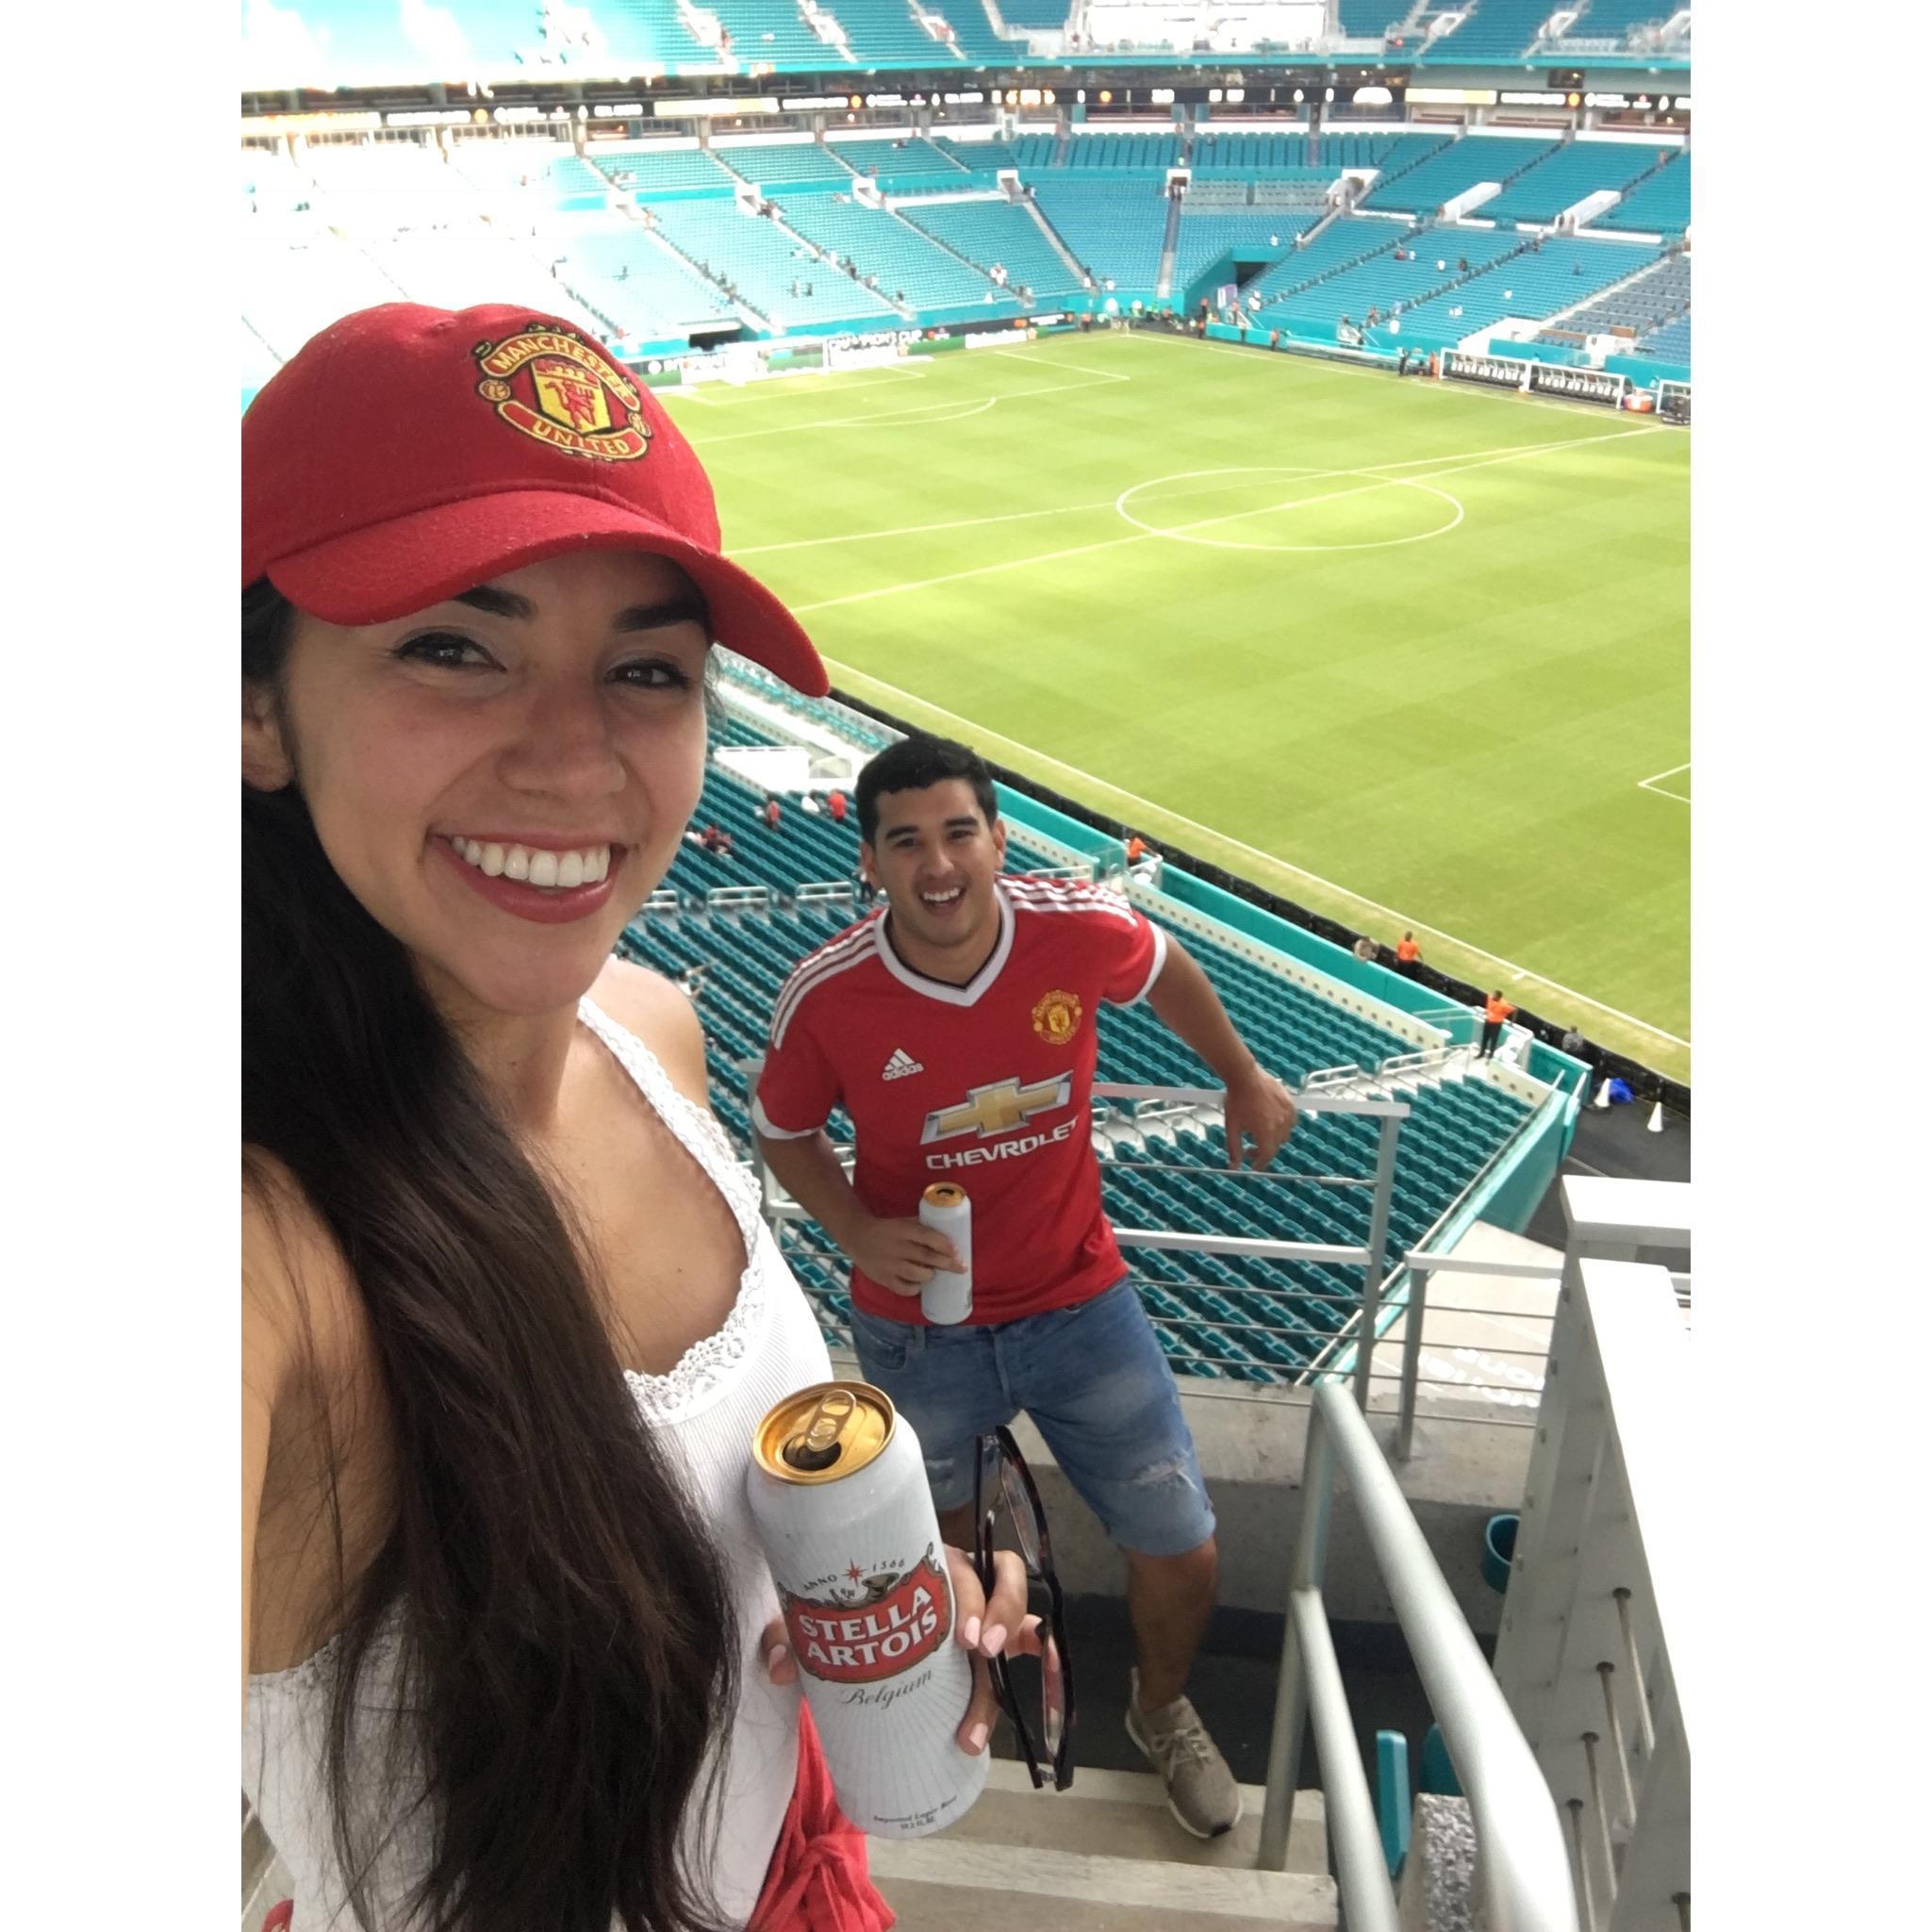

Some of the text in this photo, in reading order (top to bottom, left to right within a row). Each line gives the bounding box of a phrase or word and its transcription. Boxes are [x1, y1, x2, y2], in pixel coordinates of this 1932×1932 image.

[492, 337, 630, 398] MANCHESTER
[533, 420, 630, 454] UNITED
[882, 1063, 924, 1082] adidas
[925, 1115, 1079, 1169] CHEVROLET
[802, 1574, 838, 1592] ANNO
[799, 1585, 932, 1643] STELLA
[807, 1606, 937, 1666] ARTOIS
[842, 1669, 932, 1709] Belgium
